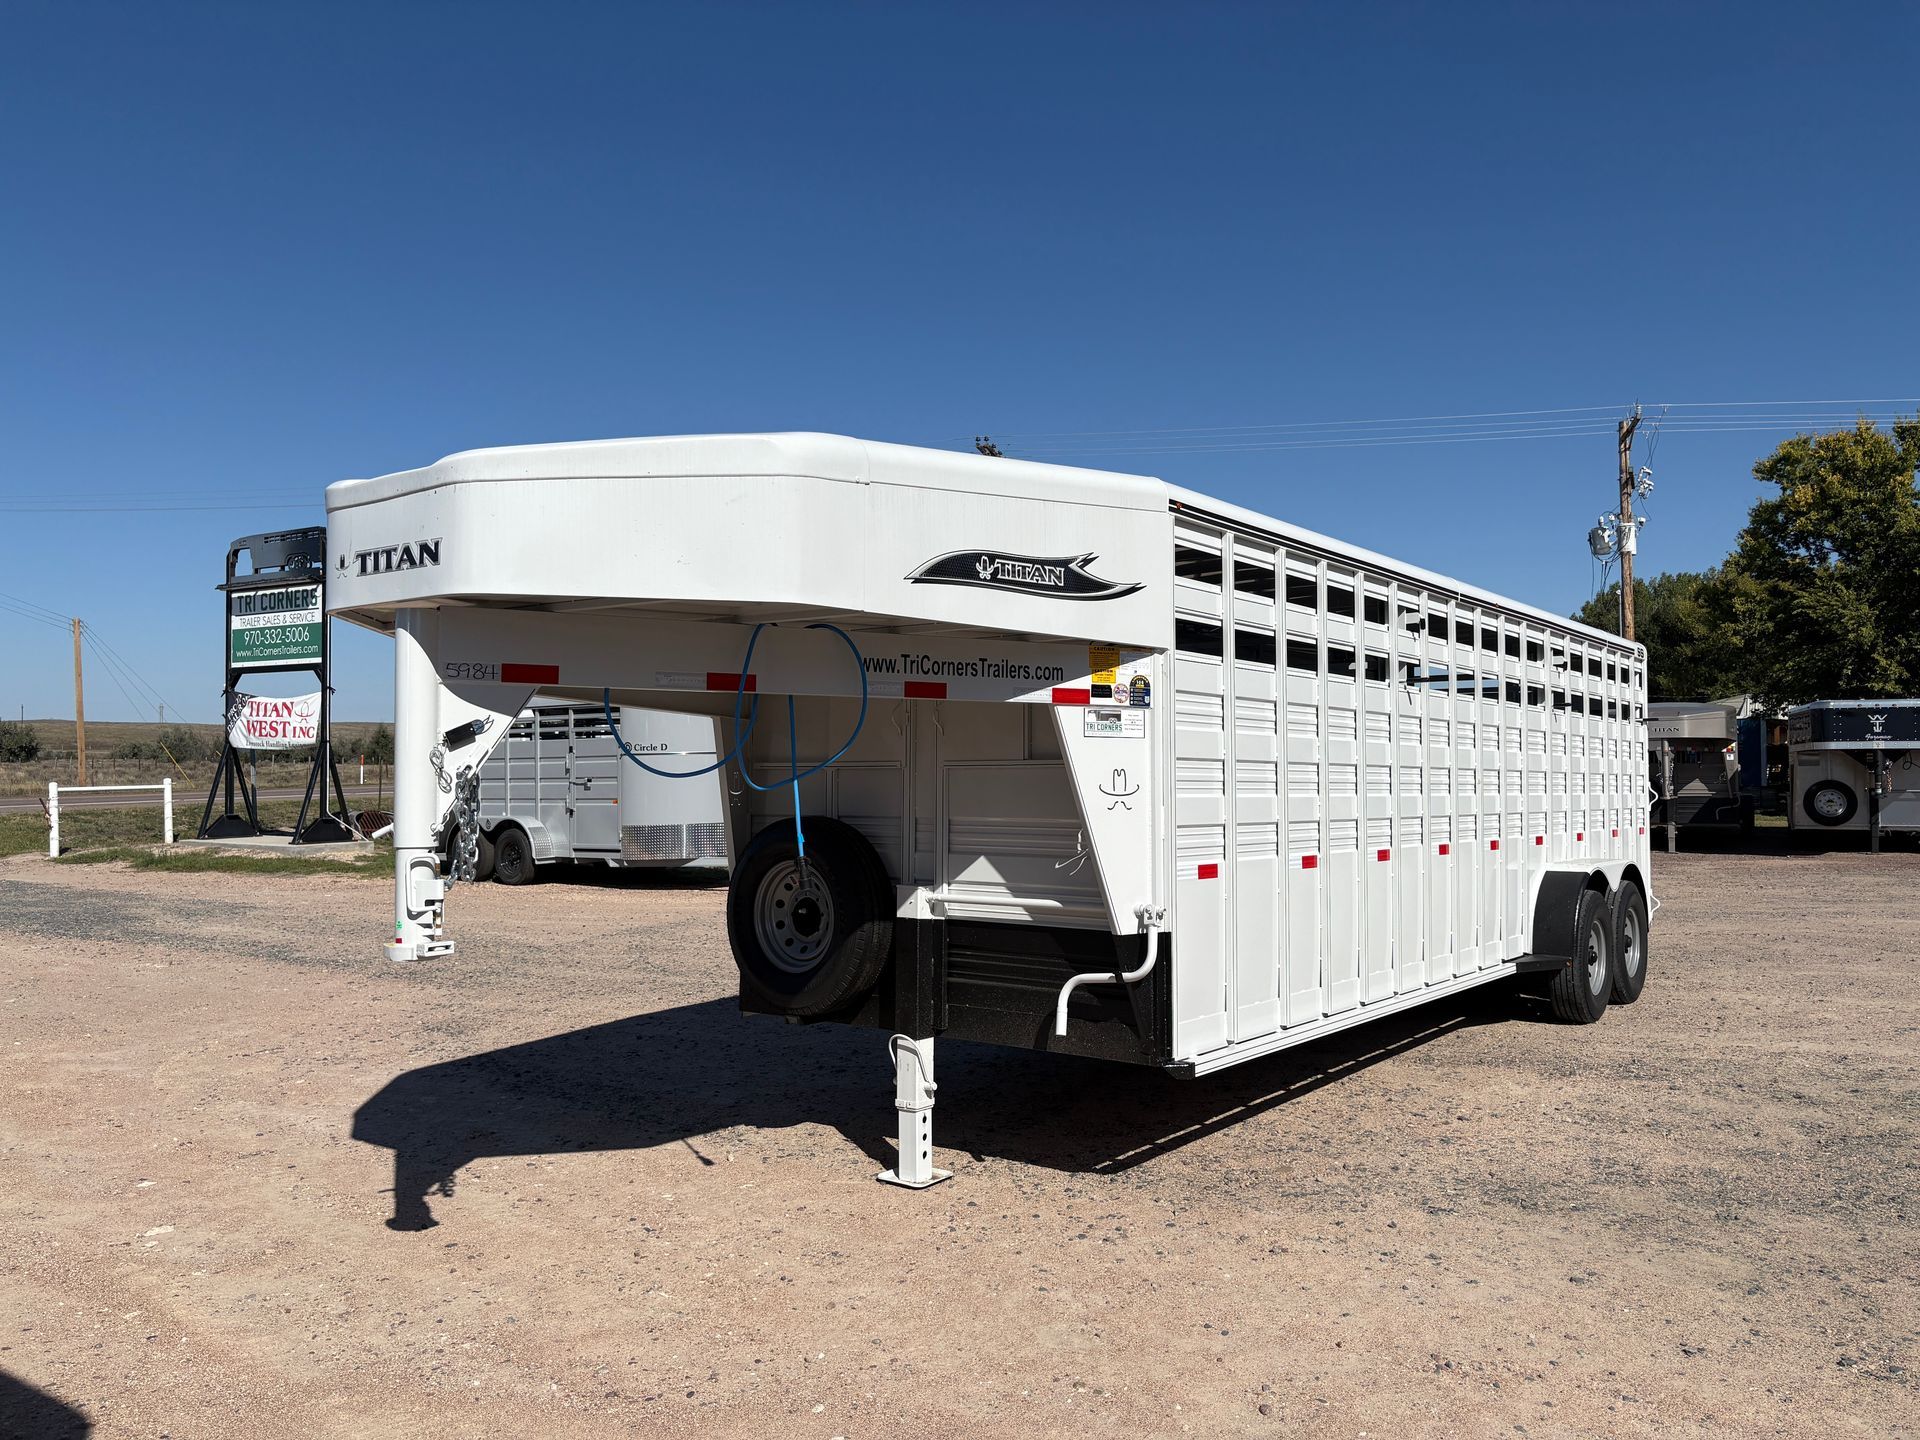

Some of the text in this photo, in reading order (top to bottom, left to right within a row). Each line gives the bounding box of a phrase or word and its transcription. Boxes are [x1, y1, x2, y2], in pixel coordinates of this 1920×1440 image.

[353, 537, 443, 577] TITAN
[994, 559, 1065, 586] TITAN
[237, 588, 318, 613] TRI CORNERS
[240, 611, 316, 627] TRAILER SALES & SERVICE
[244, 626, 310, 645] 970-332-5006
[236, 644, 319, 657] www.TriCornersTrailers.com
[446, 662, 499, 680] 5984
[863, 653, 1064, 682] www.TriCornersTrailers.com
[247, 700, 294, 718] TITAN
[246, 719, 315, 738] WEST INC
[1086, 723, 1123, 732] TRI CORNERS
[634, 743, 668, 751] Circle D
